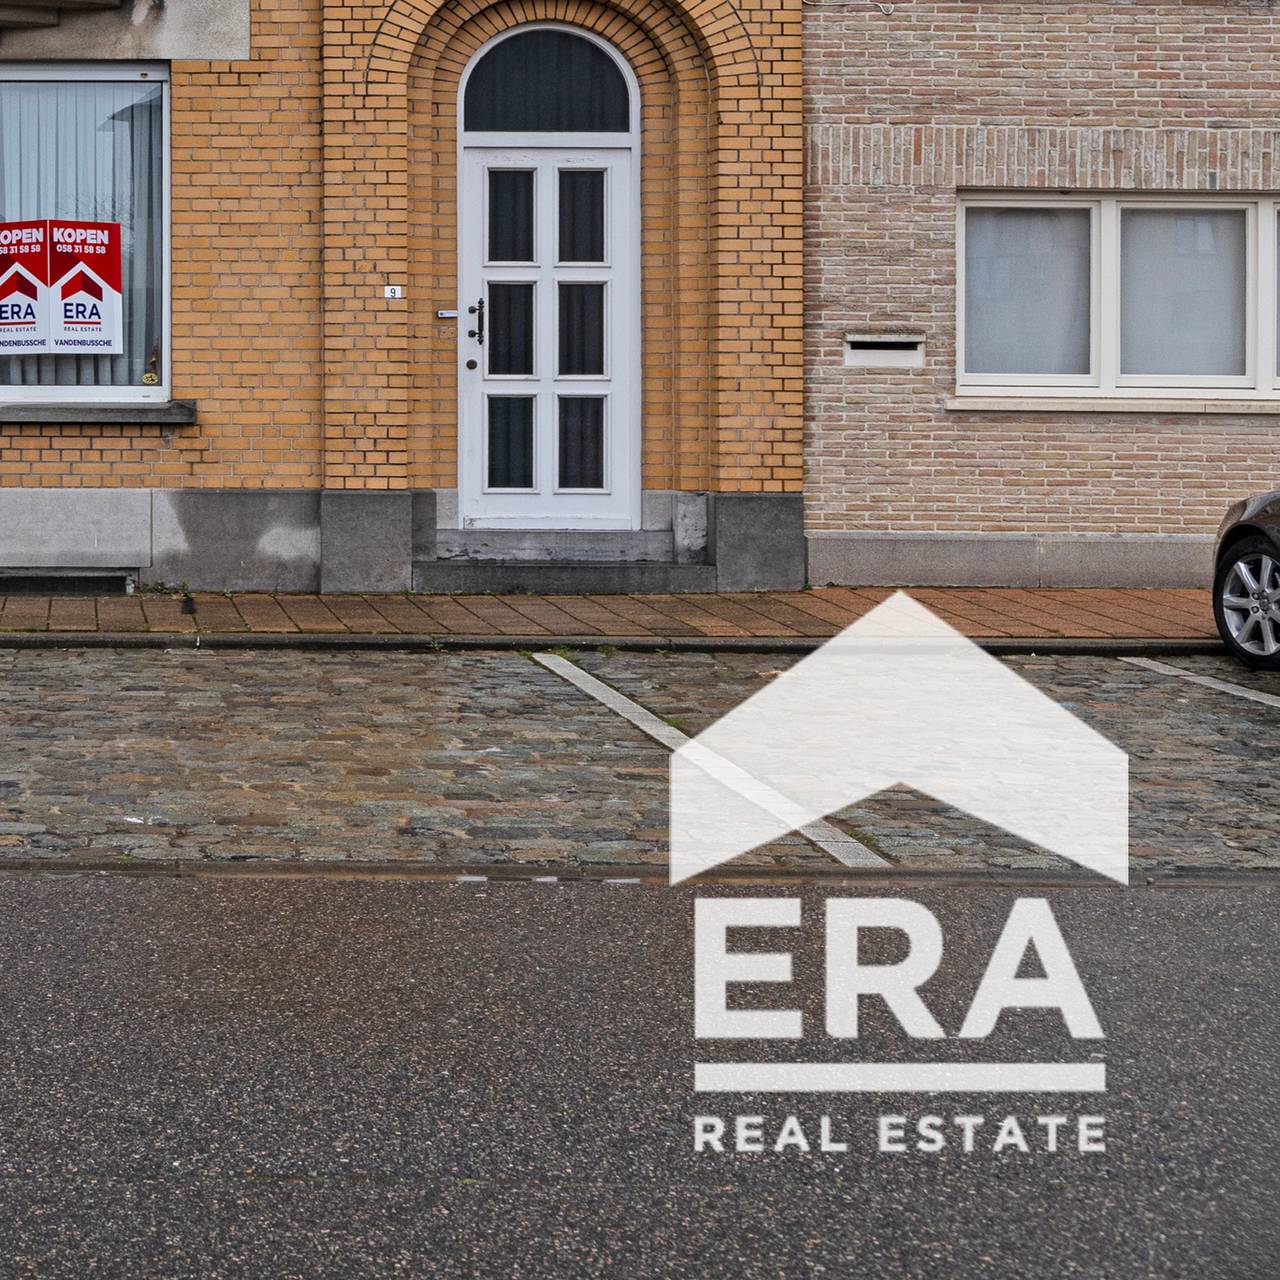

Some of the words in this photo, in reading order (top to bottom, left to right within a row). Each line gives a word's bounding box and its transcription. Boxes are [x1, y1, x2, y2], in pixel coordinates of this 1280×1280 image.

[53, 228, 109, 244] KOPEN
[9, 246, 18, 254] 31
[19, 245, 29, 253] 58
[30, 244, 41, 253] 58
[56, 244, 72, 253] 058
[73, 245, 83, 253] 31
[83, 245, 94, 254] 58
[95, 246, 106, 254] 58
[390, 287, 396, 298] 9
[0, 303, 36, 320] ERA
[64, 303, 101, 320] ERA
[54, 339, 112, 347] VANDENBUSSCHE
